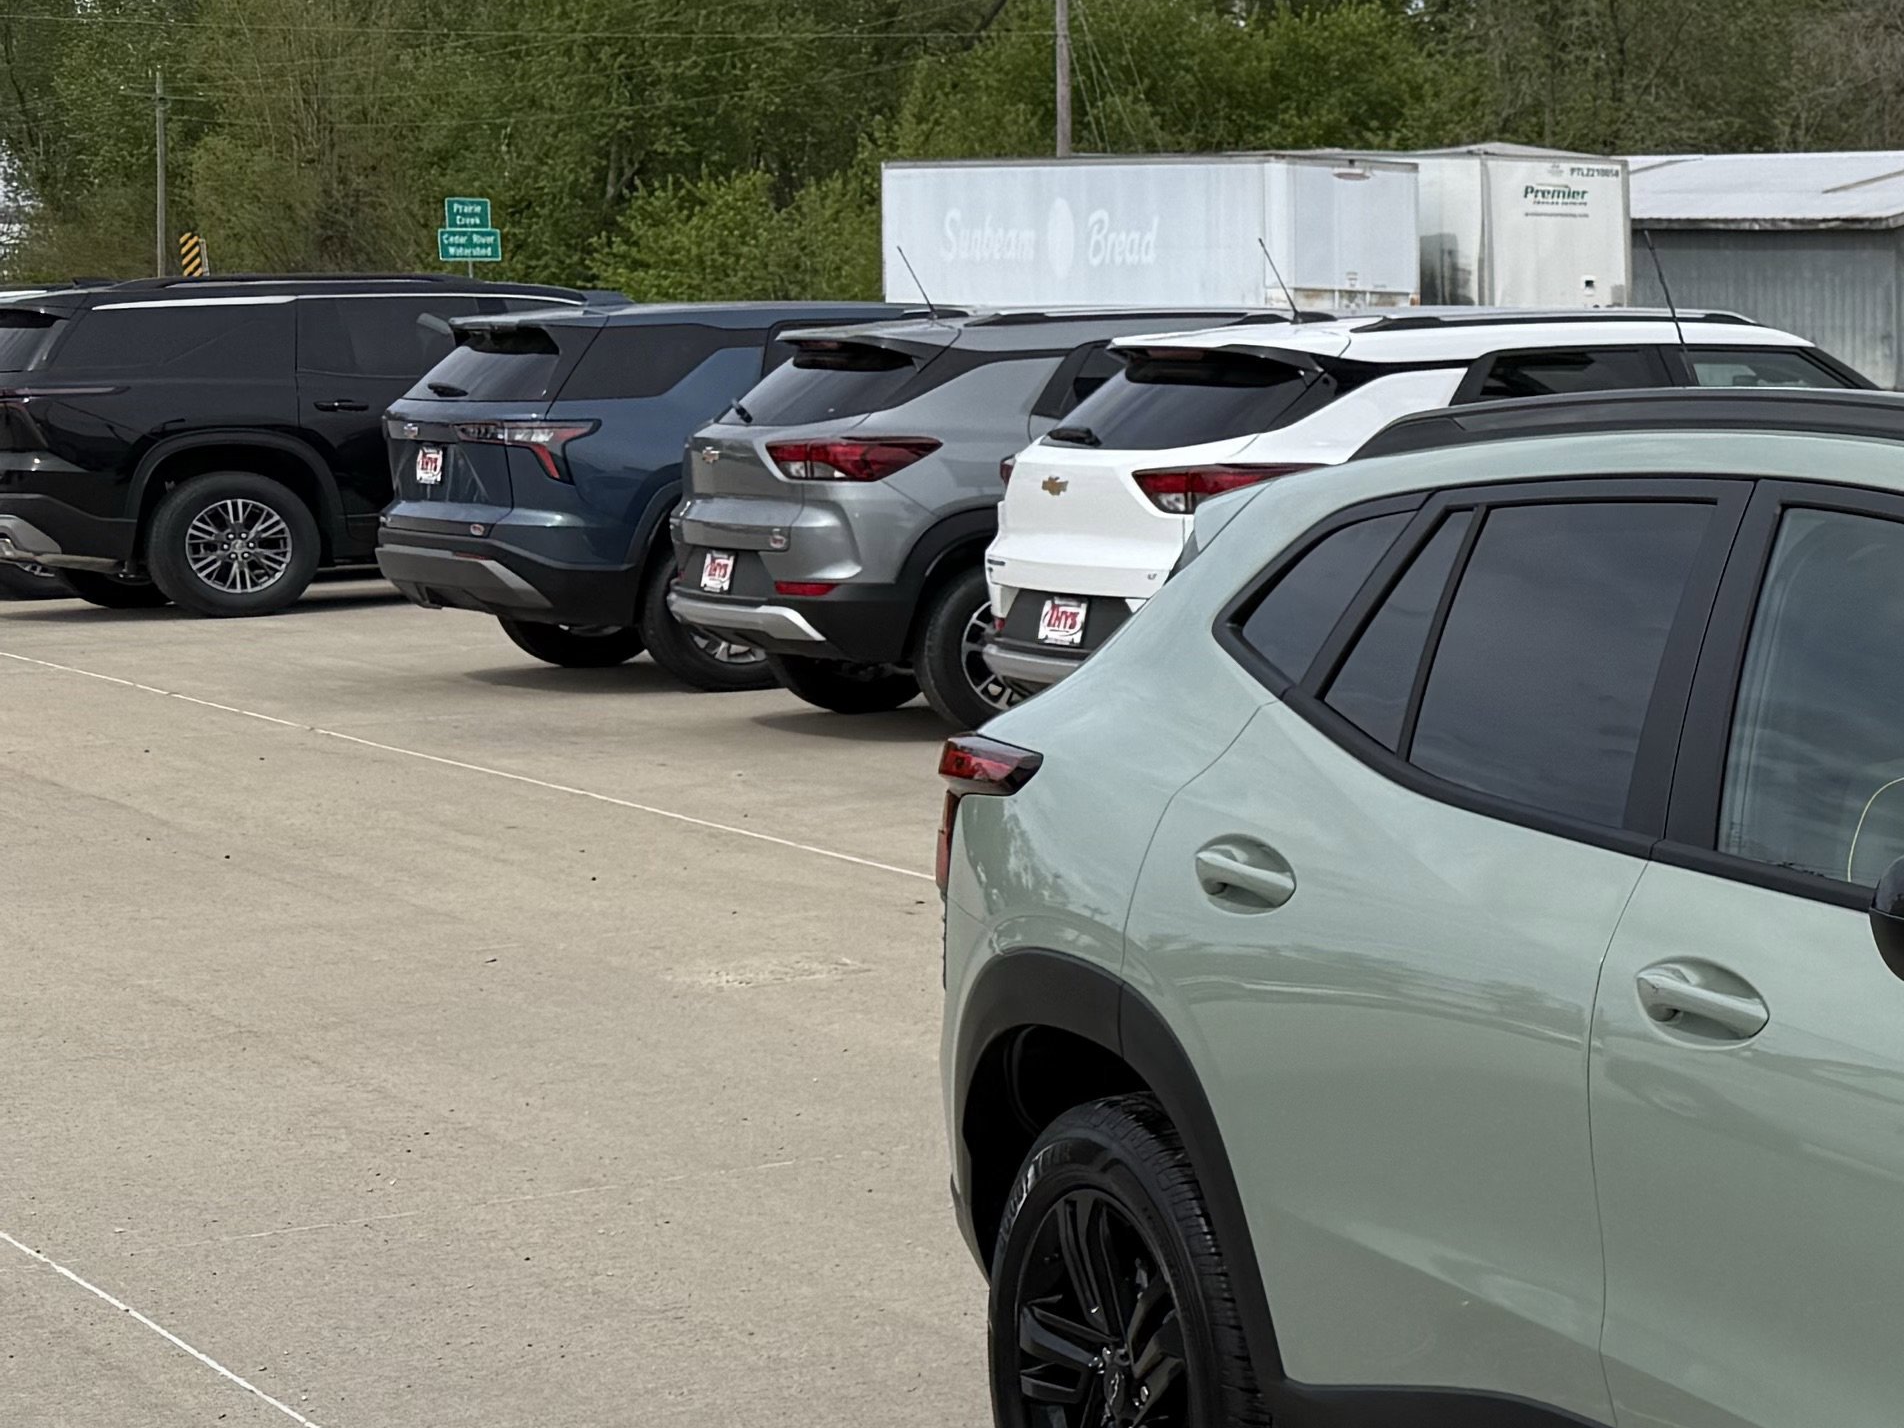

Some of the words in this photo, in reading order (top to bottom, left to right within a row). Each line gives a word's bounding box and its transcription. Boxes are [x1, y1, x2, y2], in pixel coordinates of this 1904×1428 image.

[1524, 185, 1588, 200] Premier
[442, 234, 468, 244] Cedar
[472, 234, 495, 244] River
[939, 208, 1036, 263] Sunbeam
[1088, 209, 1160, 266] Bread
[1046, 603, 1079, 630] THYS
